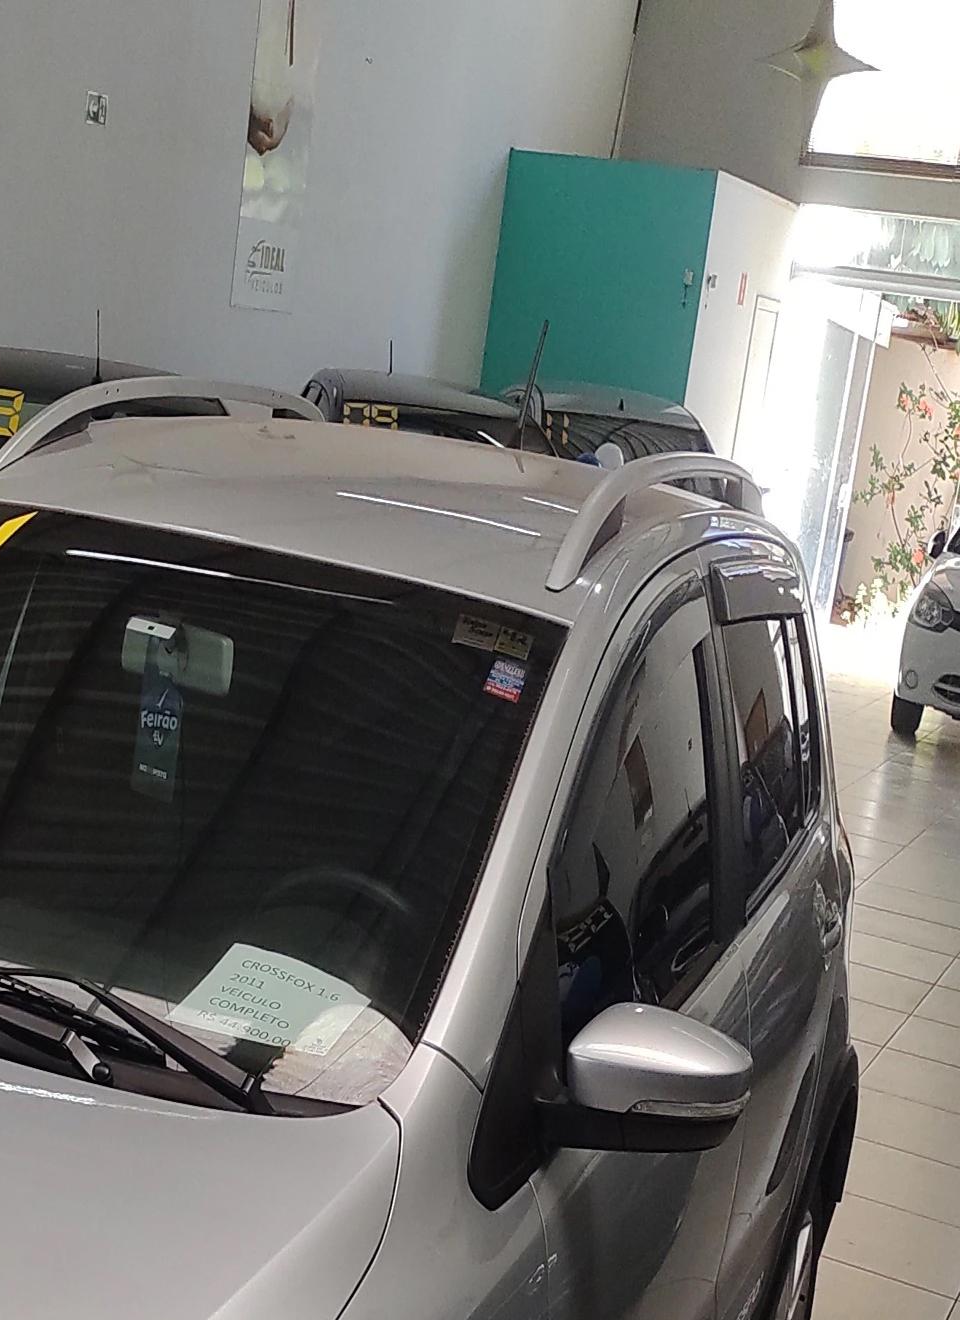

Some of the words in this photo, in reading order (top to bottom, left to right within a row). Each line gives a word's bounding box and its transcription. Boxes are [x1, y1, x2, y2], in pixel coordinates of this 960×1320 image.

[260, 245, 285, 272] IDEAL
[141, 709, 179, 731] Feirão
[230, 972, 265, 990] 2011
[241, 959, 316, 993] CROSSFOX
[317, 987, 341, 1002] 1.6
[221, 985, 282, 1010] VEICULO
[209, 997, 290, 1029] COMPLETO
